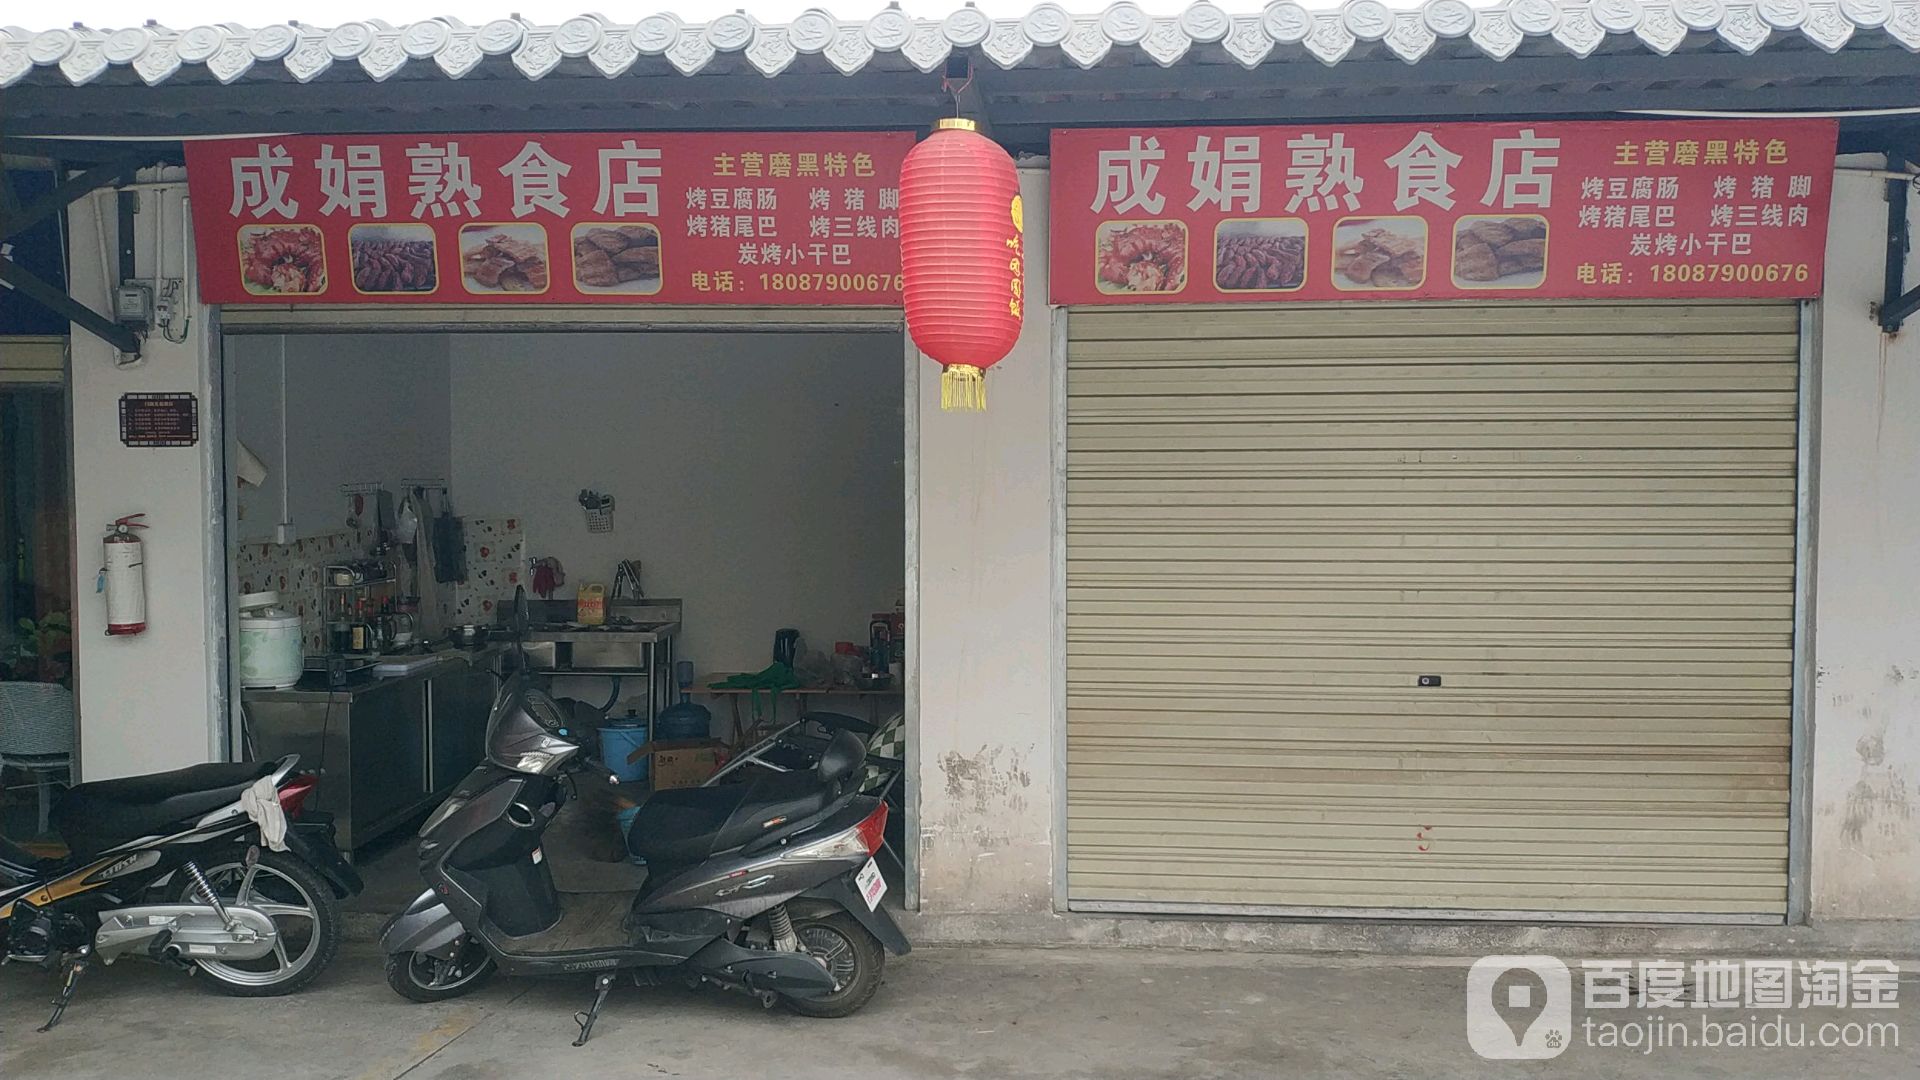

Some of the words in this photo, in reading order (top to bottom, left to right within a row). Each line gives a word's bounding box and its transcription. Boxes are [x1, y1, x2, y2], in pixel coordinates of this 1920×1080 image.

[1614, 138, 1788, 166] 主营磨黑特色
[713, 152, 876, 178] 主营磨黑特色
[1089, 129, 1560, 214] 成娟熟食店
[229, 140, 663, 219] 成娟熟食店
[1581, 176, 1679, 200] 烤豆腐肠
[686, 187, 777, 210] 烤豆腐肠
[686, 215, 777, 237] 烤猪尾巴
[809, 215, 899, 239] 烤三线肉
[1578, 205, 1675, 228] 烤猪尾巴
[1710, 204, 1808, 228] 烤三线肉
[738, 243, 851, 265] 炭烤小干巴
[1630, 233, 1751, 256] 炭烤小干巴
[759, 273, 903, 291] 18087900676
[1650, 264, 1808, 282] 18087900676
